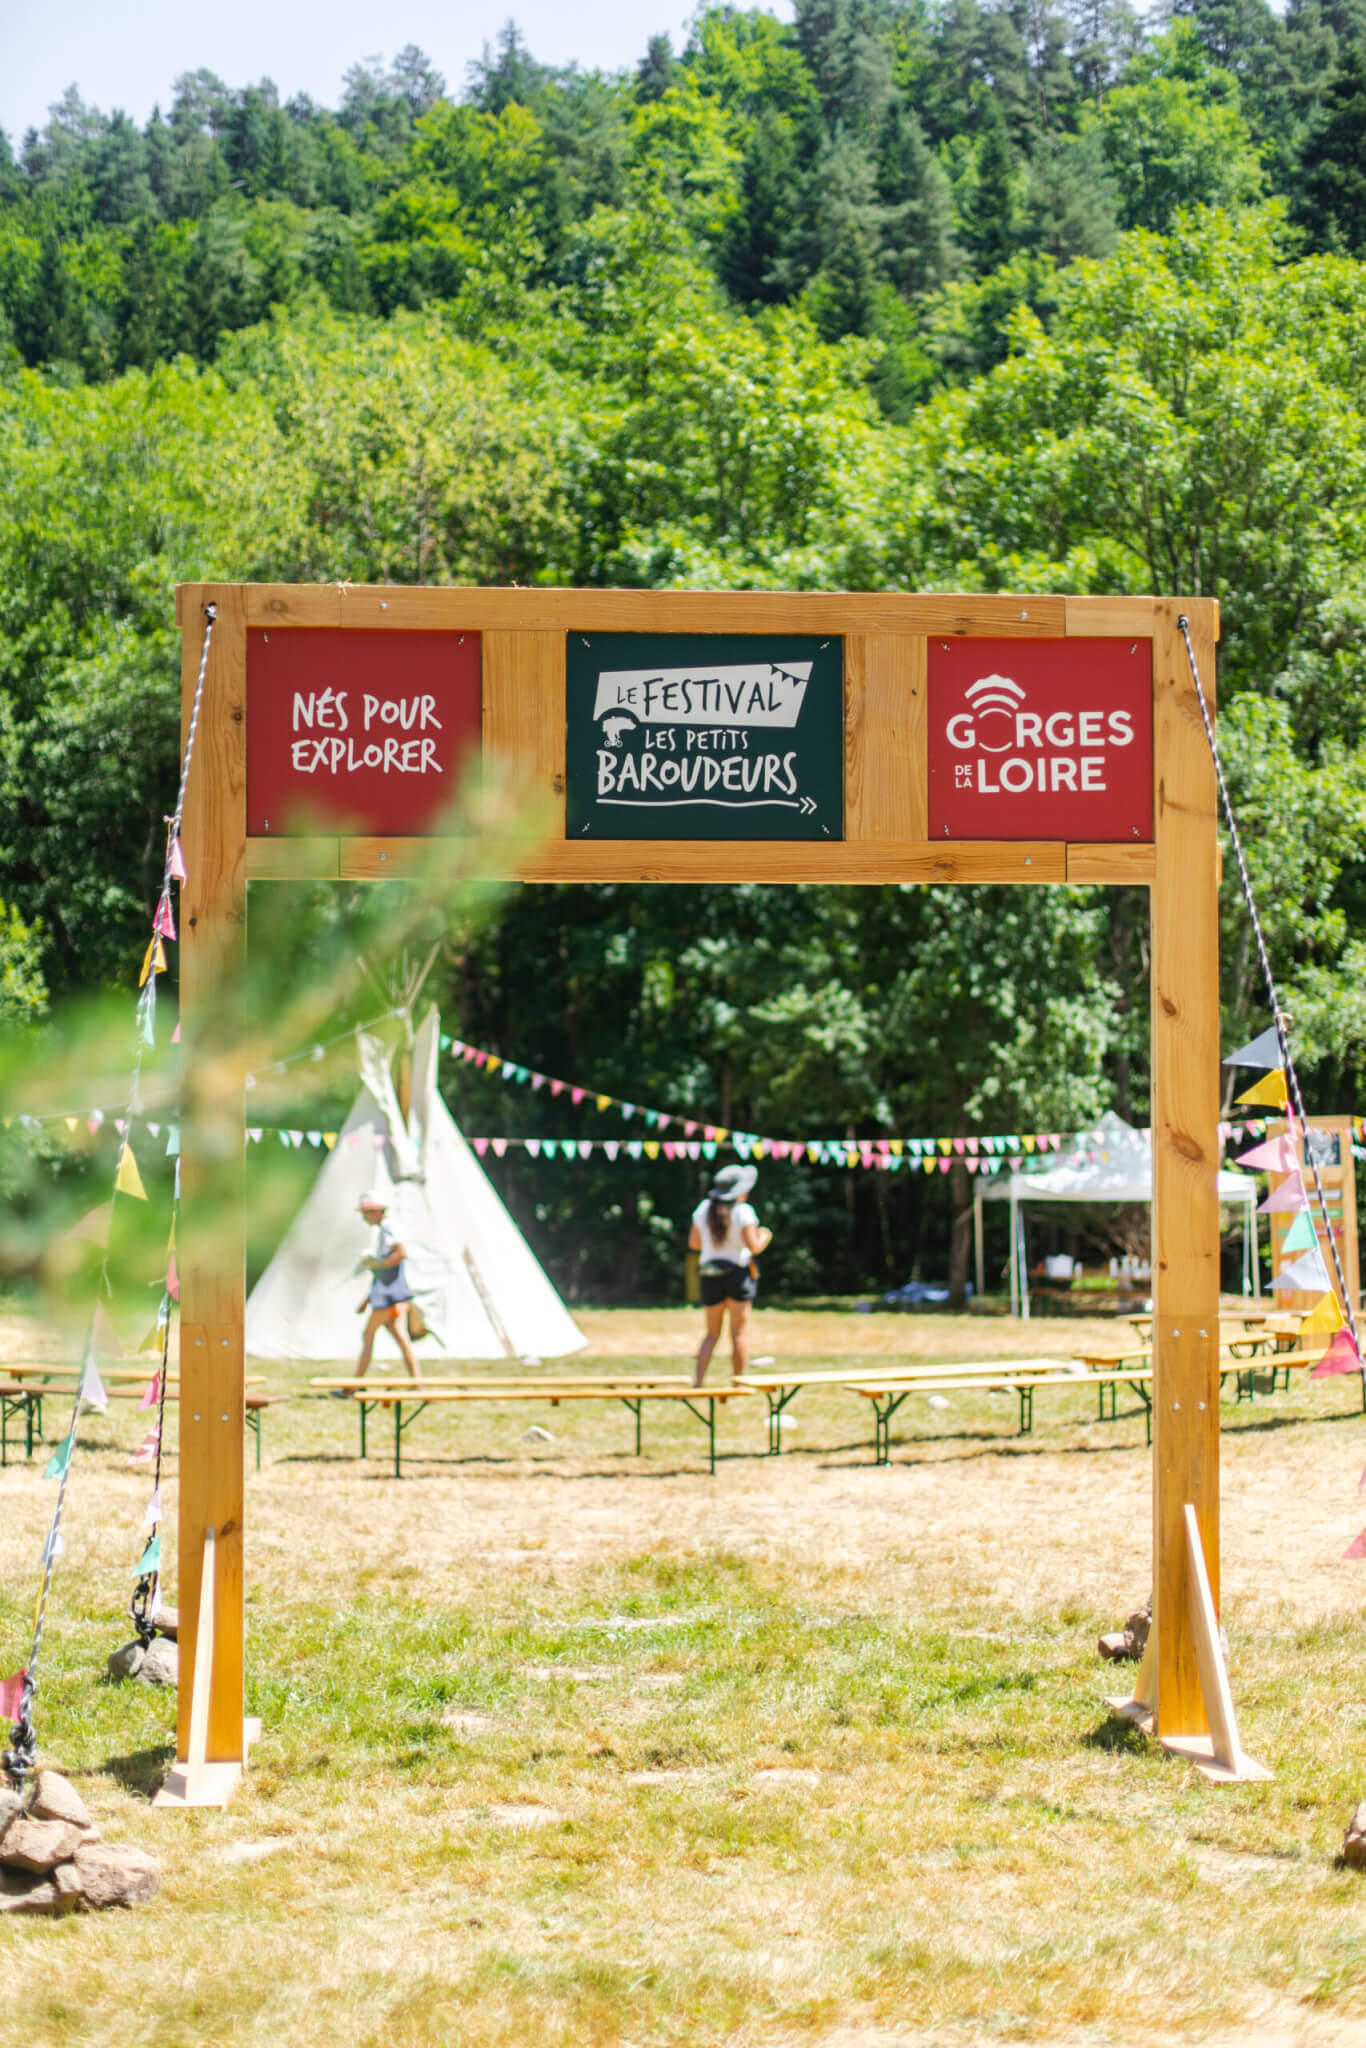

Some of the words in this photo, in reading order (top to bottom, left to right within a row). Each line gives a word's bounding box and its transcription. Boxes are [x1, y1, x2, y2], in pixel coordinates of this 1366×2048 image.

[292, 686, 348, 732] NÉS
[363, 694, 443, 732] POUR
[616, 684, 638, 704] LE
[642, 677, 783, 716] FESTIVAL
[644, 728, 676, 751] LES
[685, 728, 749, 751] PETITS
[945, 705, 1135, 753] GORGES
[290, 736, 443, 775] EXPLORER
[595, 749, 798, 796] BAROUDEURS
[954, 764, 973, 776] DE
[977, 756, 1107, 794] LOIRE
[954, 777, 973, 788] LA
